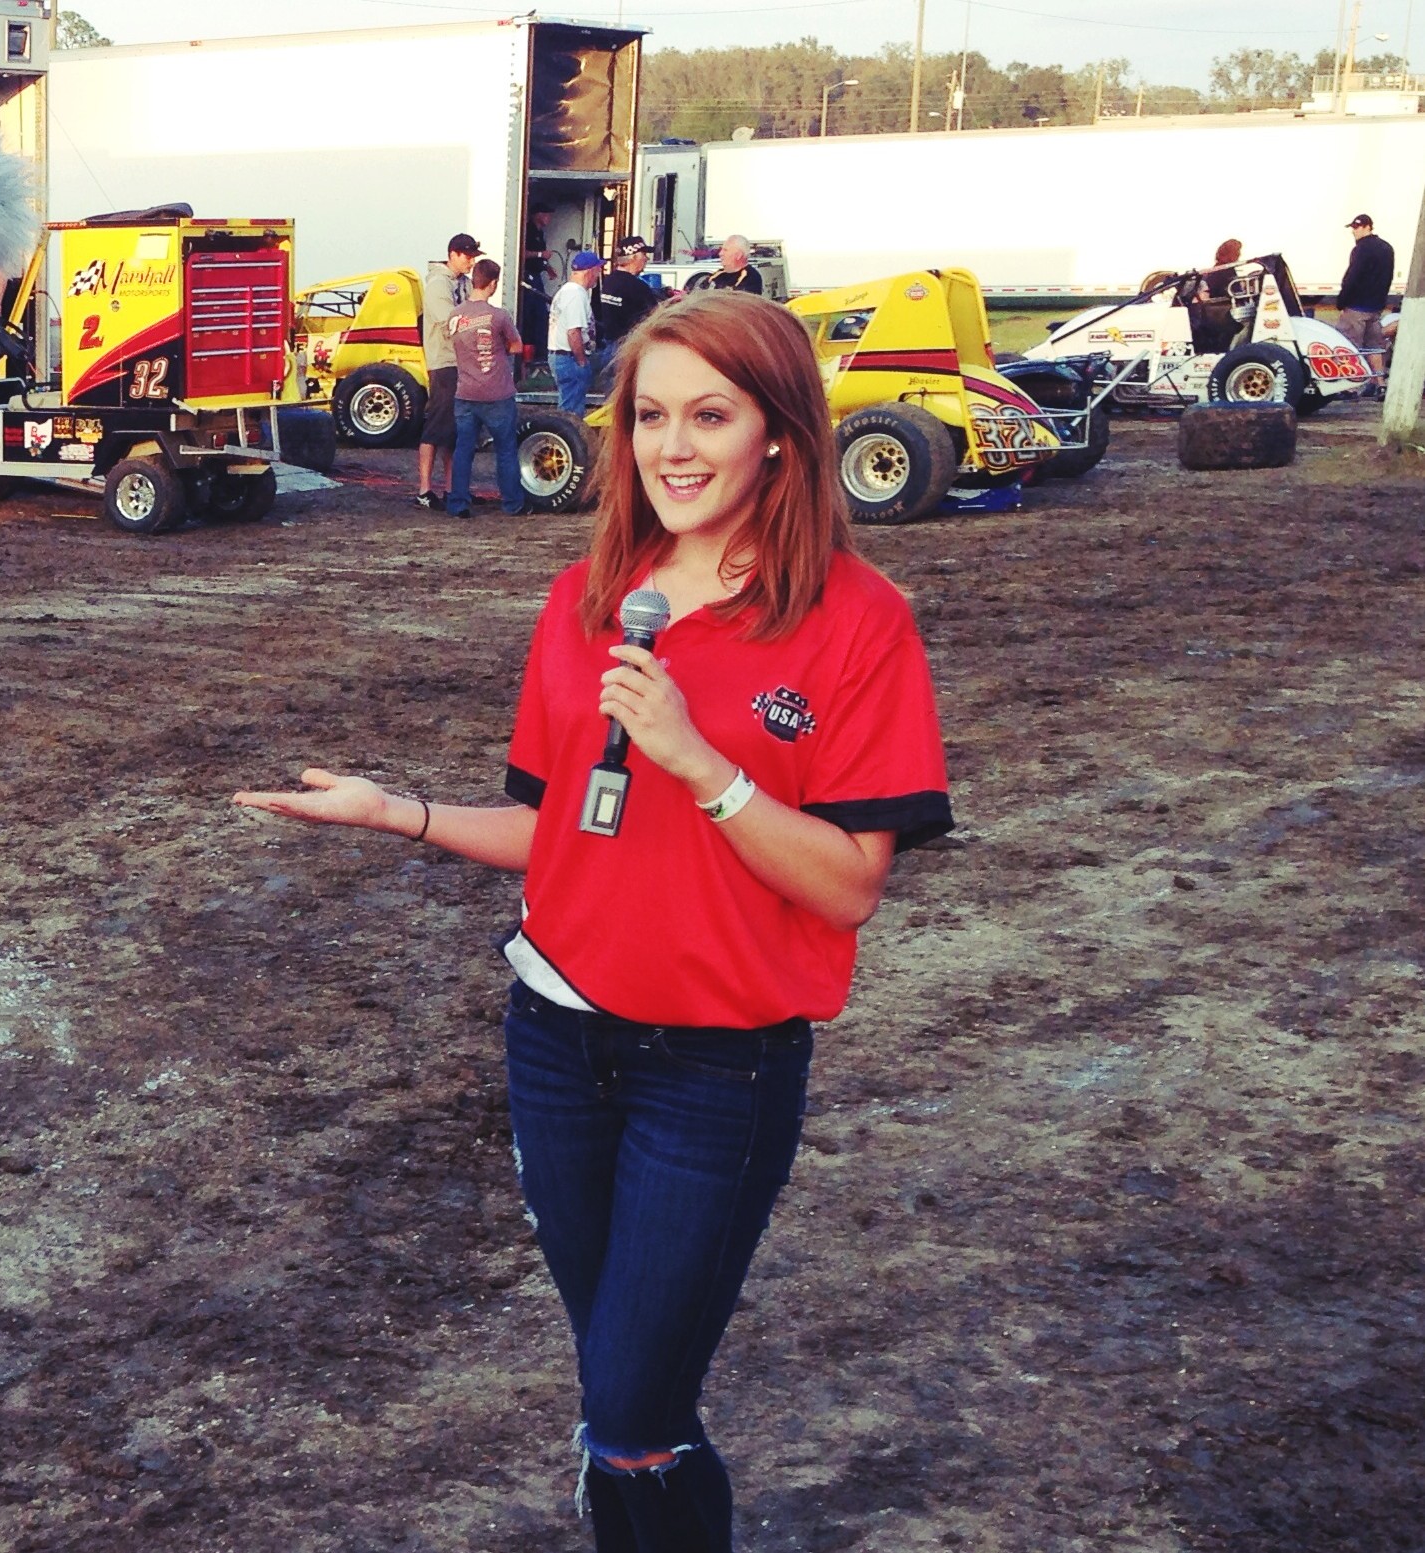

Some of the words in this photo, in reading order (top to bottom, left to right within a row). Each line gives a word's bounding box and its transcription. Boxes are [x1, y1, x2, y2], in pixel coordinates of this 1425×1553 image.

[92, 261, 176, 296] Marshall
[119, 289, 171, 297] MOTORSPORTS
[908, 376, 941, 386] Hoosier
[395, 380, 412, 420] Hoosier
[843, 415, 900, 438] Hoosier
[551, 464, 585, 507] Hoosier
[768, 704, 799, 729] USA
